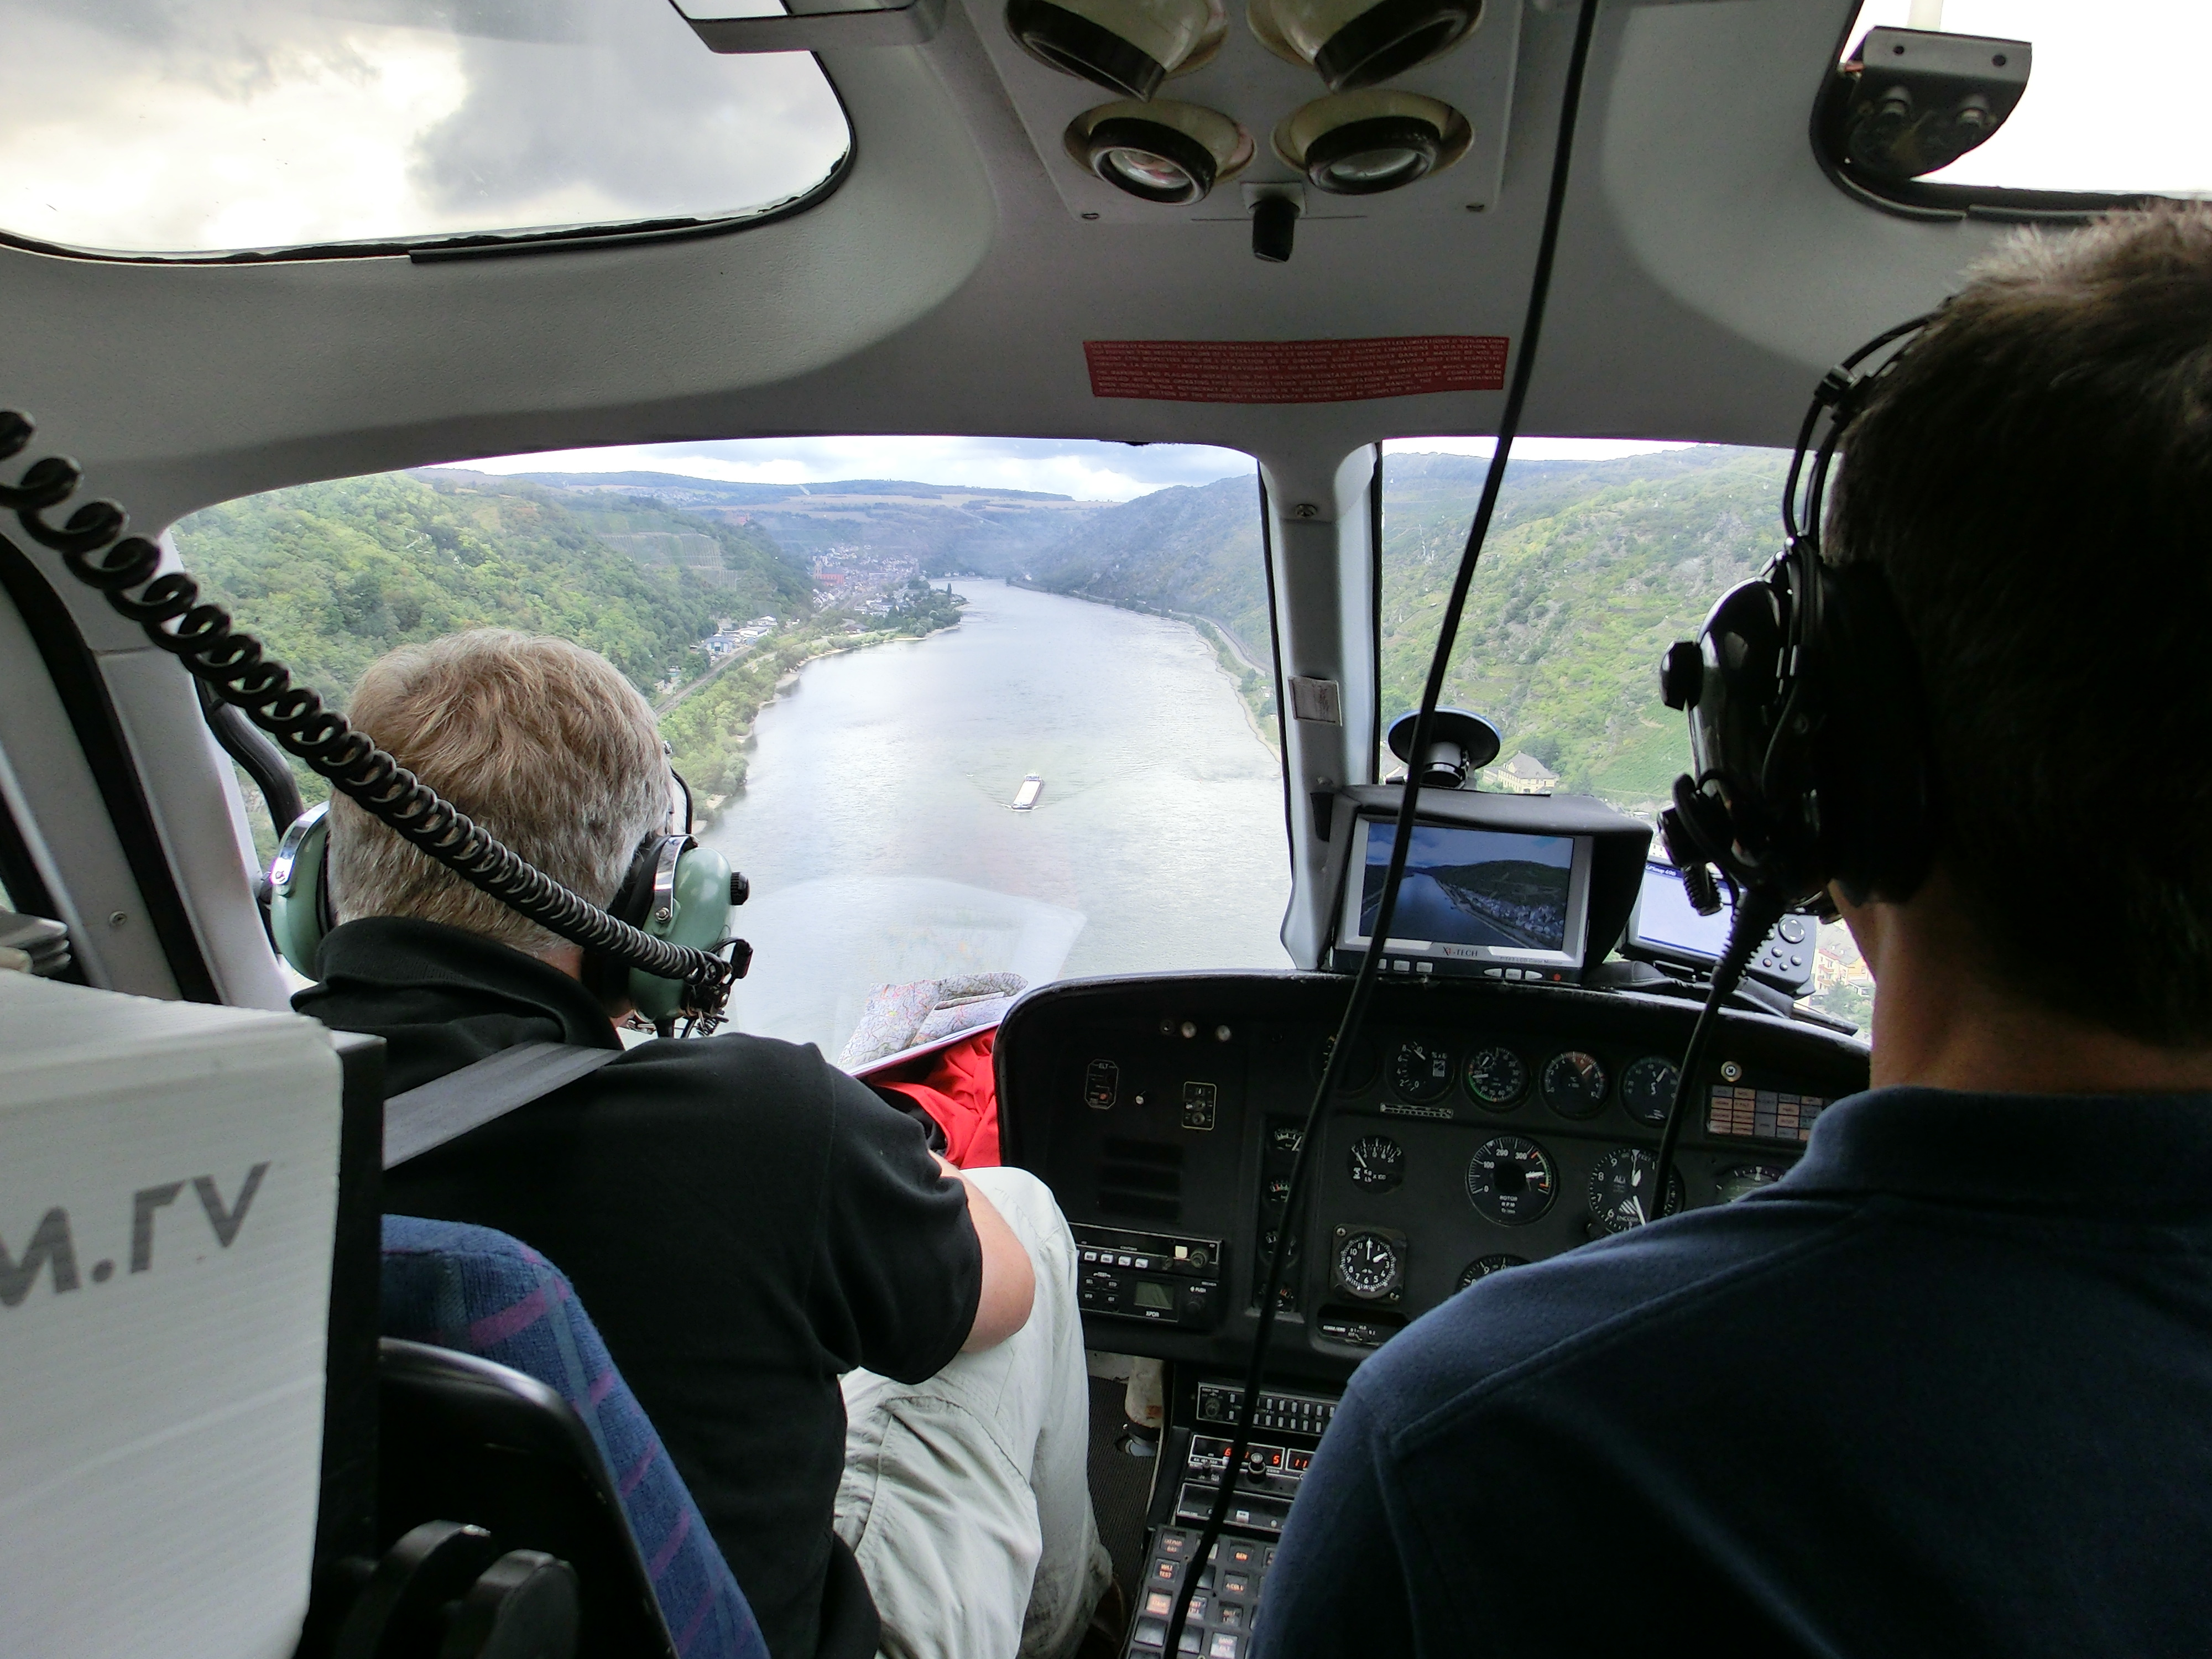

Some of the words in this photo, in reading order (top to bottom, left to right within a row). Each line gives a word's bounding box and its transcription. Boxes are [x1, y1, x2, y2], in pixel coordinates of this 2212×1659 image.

[1414, 1080, 1420, 1088] 0
[1496, 1149, 1509, 1157] 200
[1610, 1158, 1618, 1167] 9
[1598, 1171, 1604, 1182] 8
[1483, 1185, 1489, 1193] 0
[1597, 1192, 1603, 1202] 7
[1607, 1208, 1615, 1218] 6
[1358, 1241, 1364, 1250] 11
[1349, 1248, 1358, 1256] 10
[1346, 1255, 1352, 1264] 9
[1384, 1260, 1390, 1269] 3
[1380, 1269, 1386, 1277] 4
[1363, 1276, 1370, 1284] 6
[1373, 1275, 1379, 1284] 5
[1272, 1454, 1281, 1464] 5
